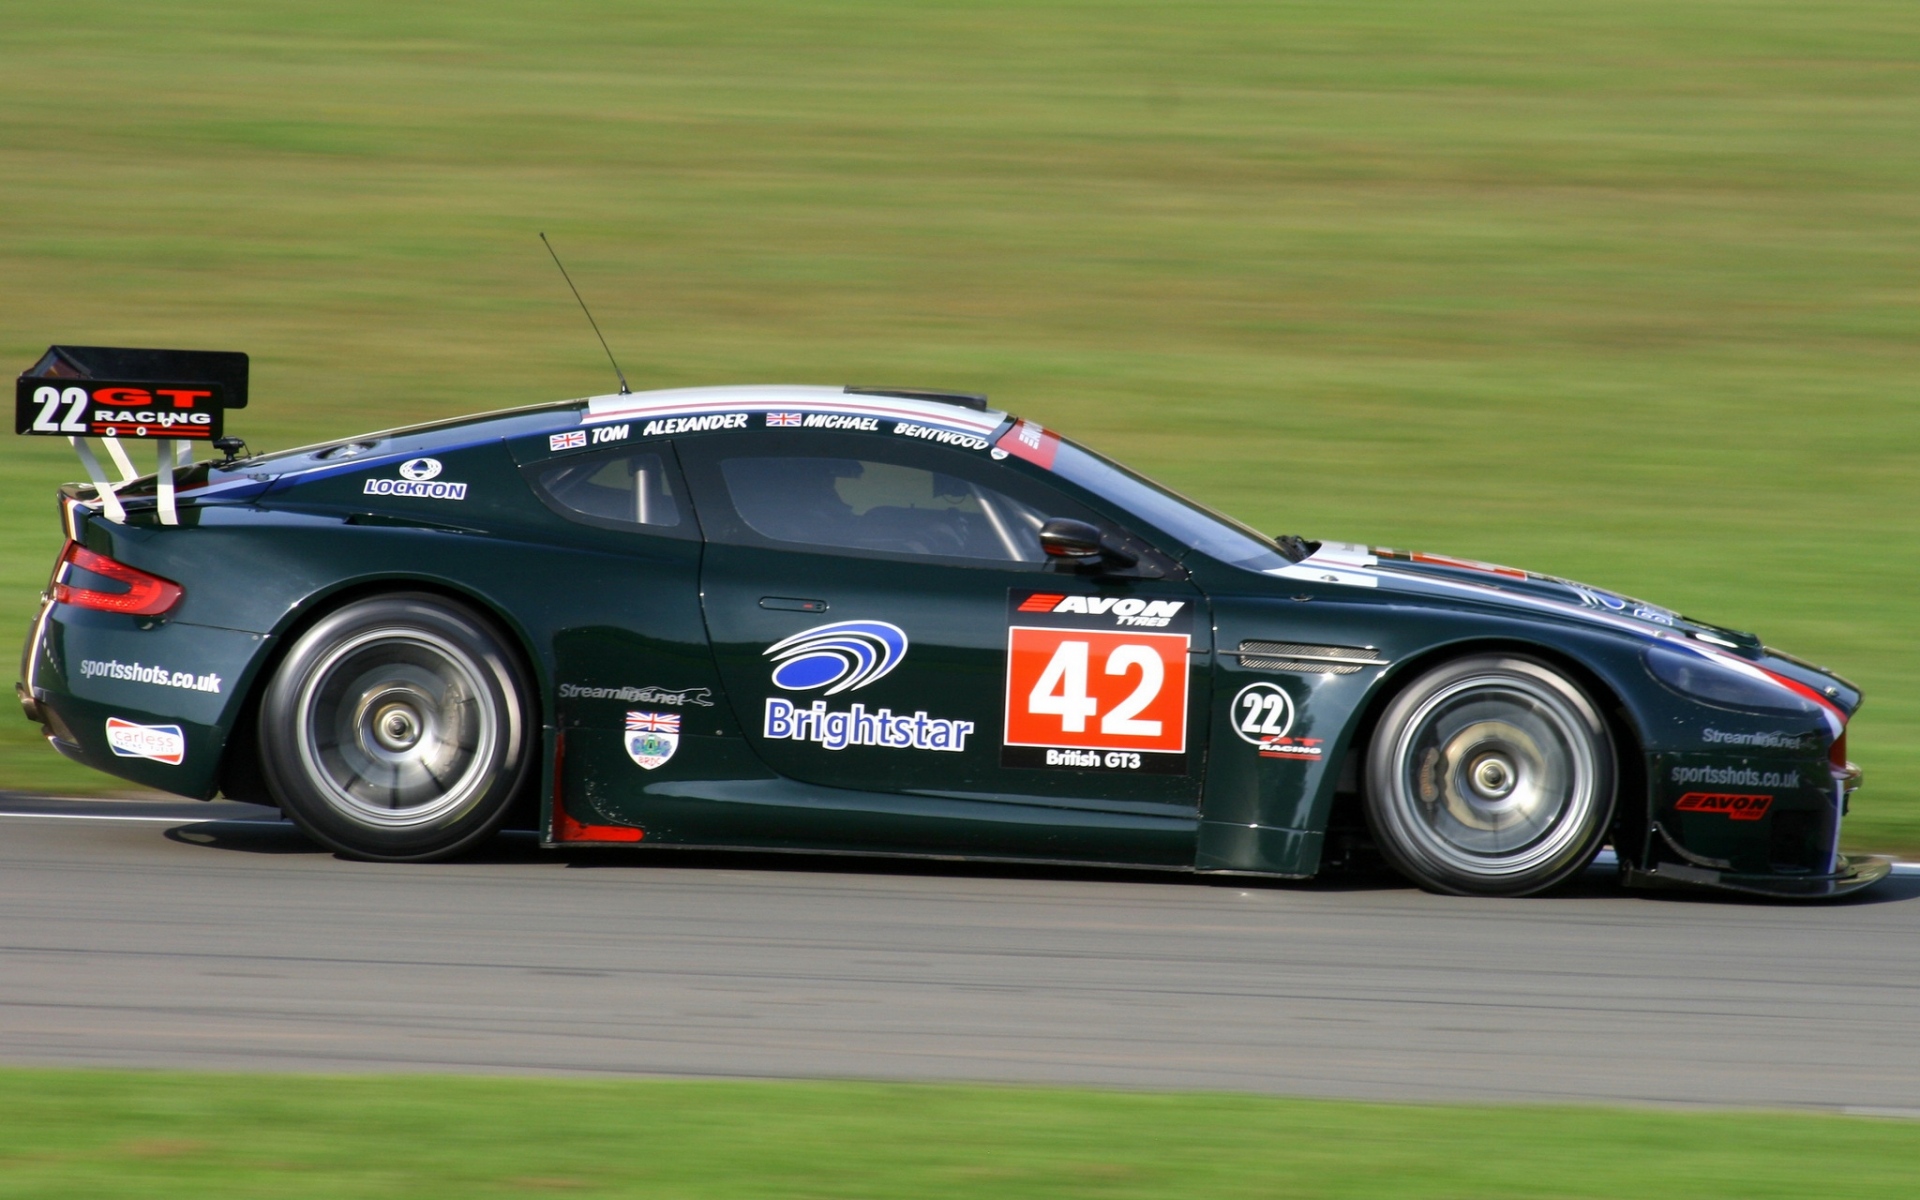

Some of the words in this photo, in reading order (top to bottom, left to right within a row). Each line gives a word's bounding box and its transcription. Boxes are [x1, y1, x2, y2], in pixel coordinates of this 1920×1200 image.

[33, 386, 88, 432] 22
[92, 387, 212, 408] GT
[95, 410, 211, 424] RACING
[592, 424, 629, 444] TOM
[643, 413, 748, 436] ALEXANDER
[803, 413, 879, 431] MICHAEL
[893, 422, 989, 450] BENTWOOD
[363, 479, 467, 500] LOCKTON
[1052, 595, 1185, 618] AVON
[1116, 615, 1171, 627] TYRES
[80, 658, 222, 694] sportsshots.co.uk
[559, 683, 686, 706] Streamline.net
[1028, 640, 1165, 736] 42
[763, 697, 974, 752] Brightstar
[1241, 692, 1284, 735] 22
[114, 731, 174, 747] carless
[1259, 744, 1322, 754] RACING
[1046, 749, 1100, 767] British
[1104, 752, 1141, 769] GT3
[1671, 765, 1801, 788] sportsshots.co.uk
[1700, 796, 1770, 810] AVON
